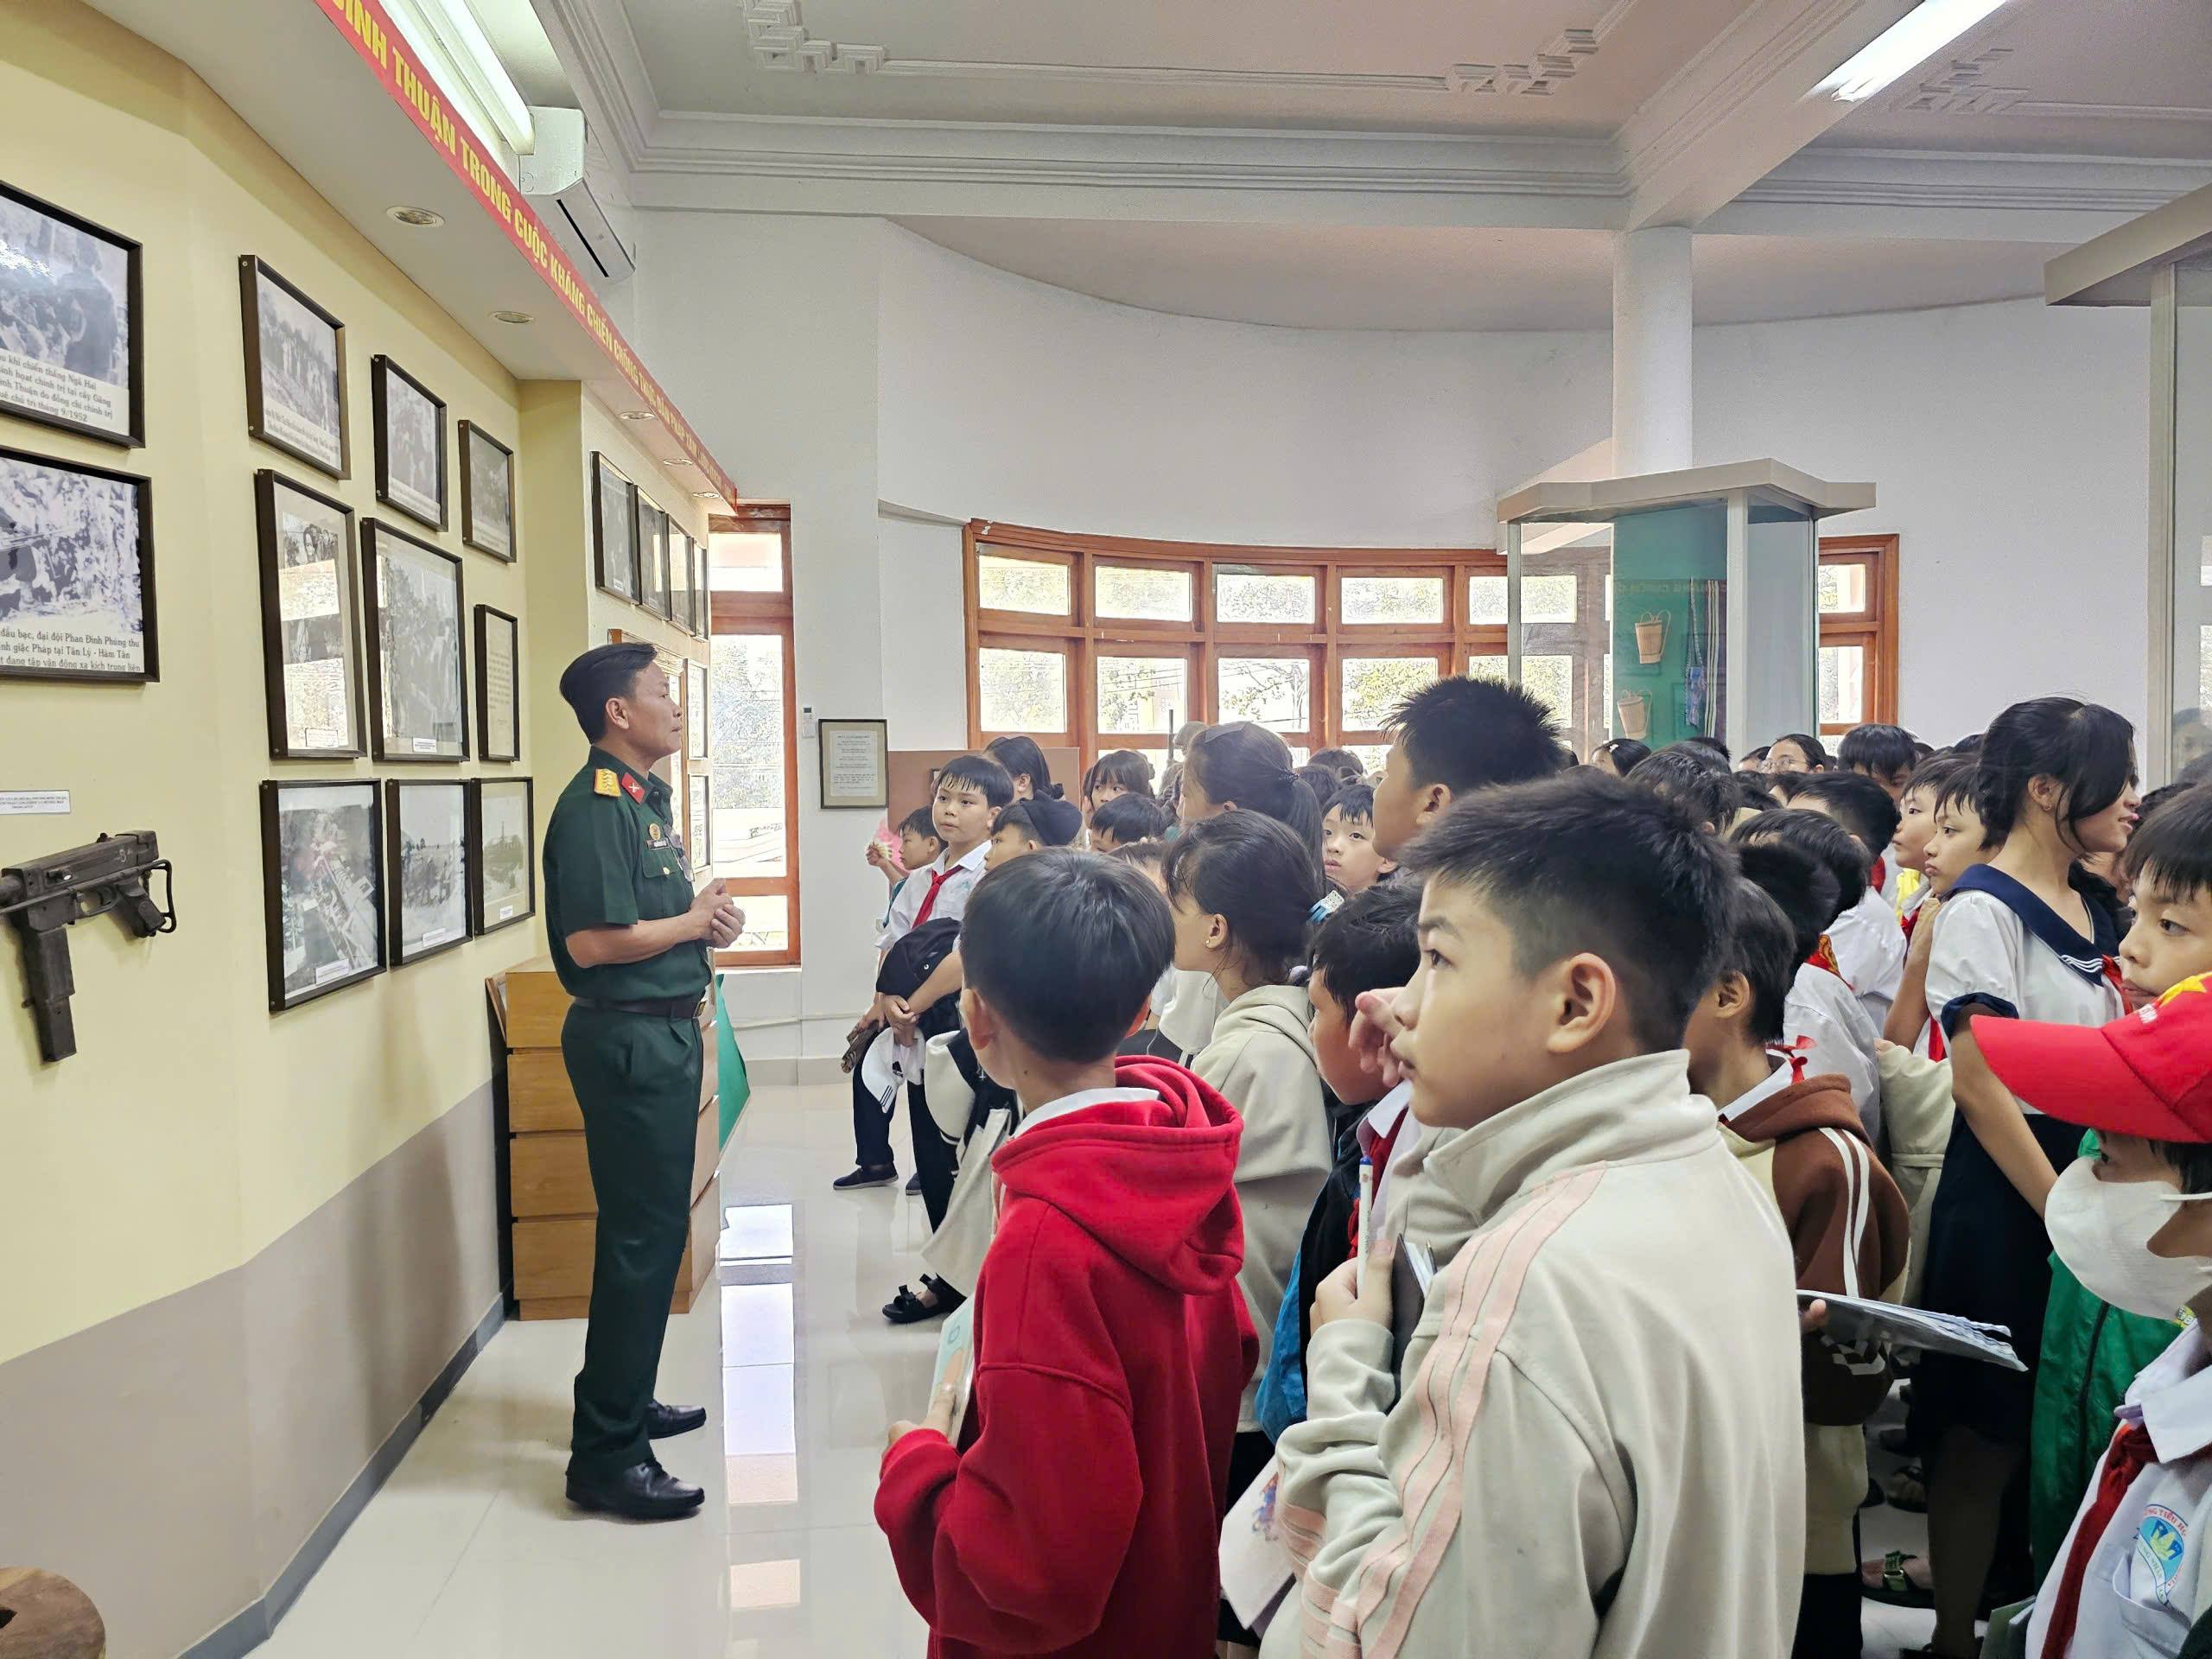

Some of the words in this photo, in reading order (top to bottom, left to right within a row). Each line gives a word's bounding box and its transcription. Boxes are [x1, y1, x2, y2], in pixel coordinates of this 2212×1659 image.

[392, 46, 455, 156] THUẬN
[460, 136, 512, 224] TRONG
[514, 208, 548, 269] CUỘC
[550, 253, 586, 318] KHÁNG
[588, 303, 613, 352] CHIẾN
[9, 354, 21, 366] khi
[41, 391, 49, 399] do
[60, 408, 88, 422] 9/1952
[36, 631, 48, 641] đại
[51, 632, 63, 643] đội
[65, 632, 84, 643] Phan
[128, 639, 139, 648] thu
[32, 644, 52, 656] Pháp
[54, 645, 64, 656] tại
